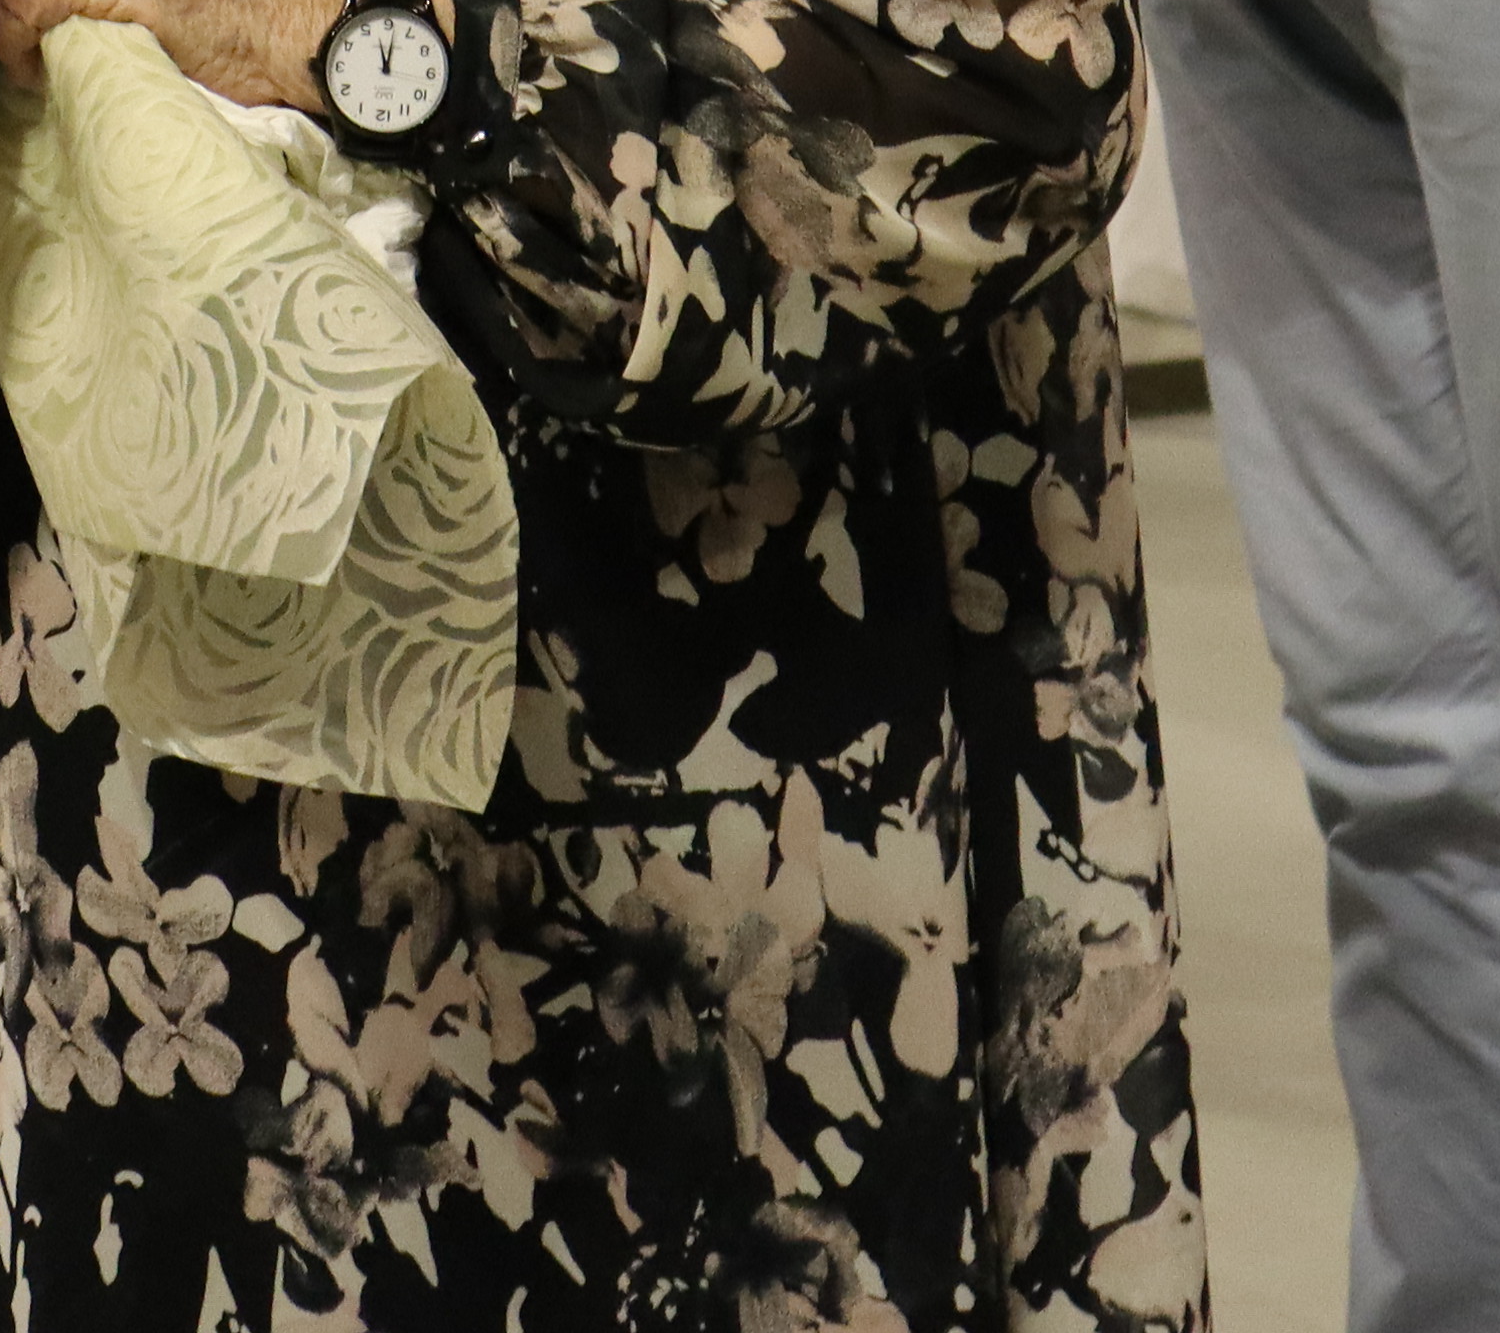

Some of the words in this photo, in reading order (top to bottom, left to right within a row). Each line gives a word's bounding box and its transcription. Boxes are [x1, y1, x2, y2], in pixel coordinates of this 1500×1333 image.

[360, 23, 371, 36] 5
[383, 18, 394, 31] 6
[405, 26, 416, 39] 7
[420, 44, 430, 57] 8
[335, 60, 346, 73] 3
[426, 67, 437, 79] 9
[340, 83, 351, 96] 2
[414, 88, 428, 102] 10
[375, 109, 391, 122] 12
[399, 103, 410, 116] 11
